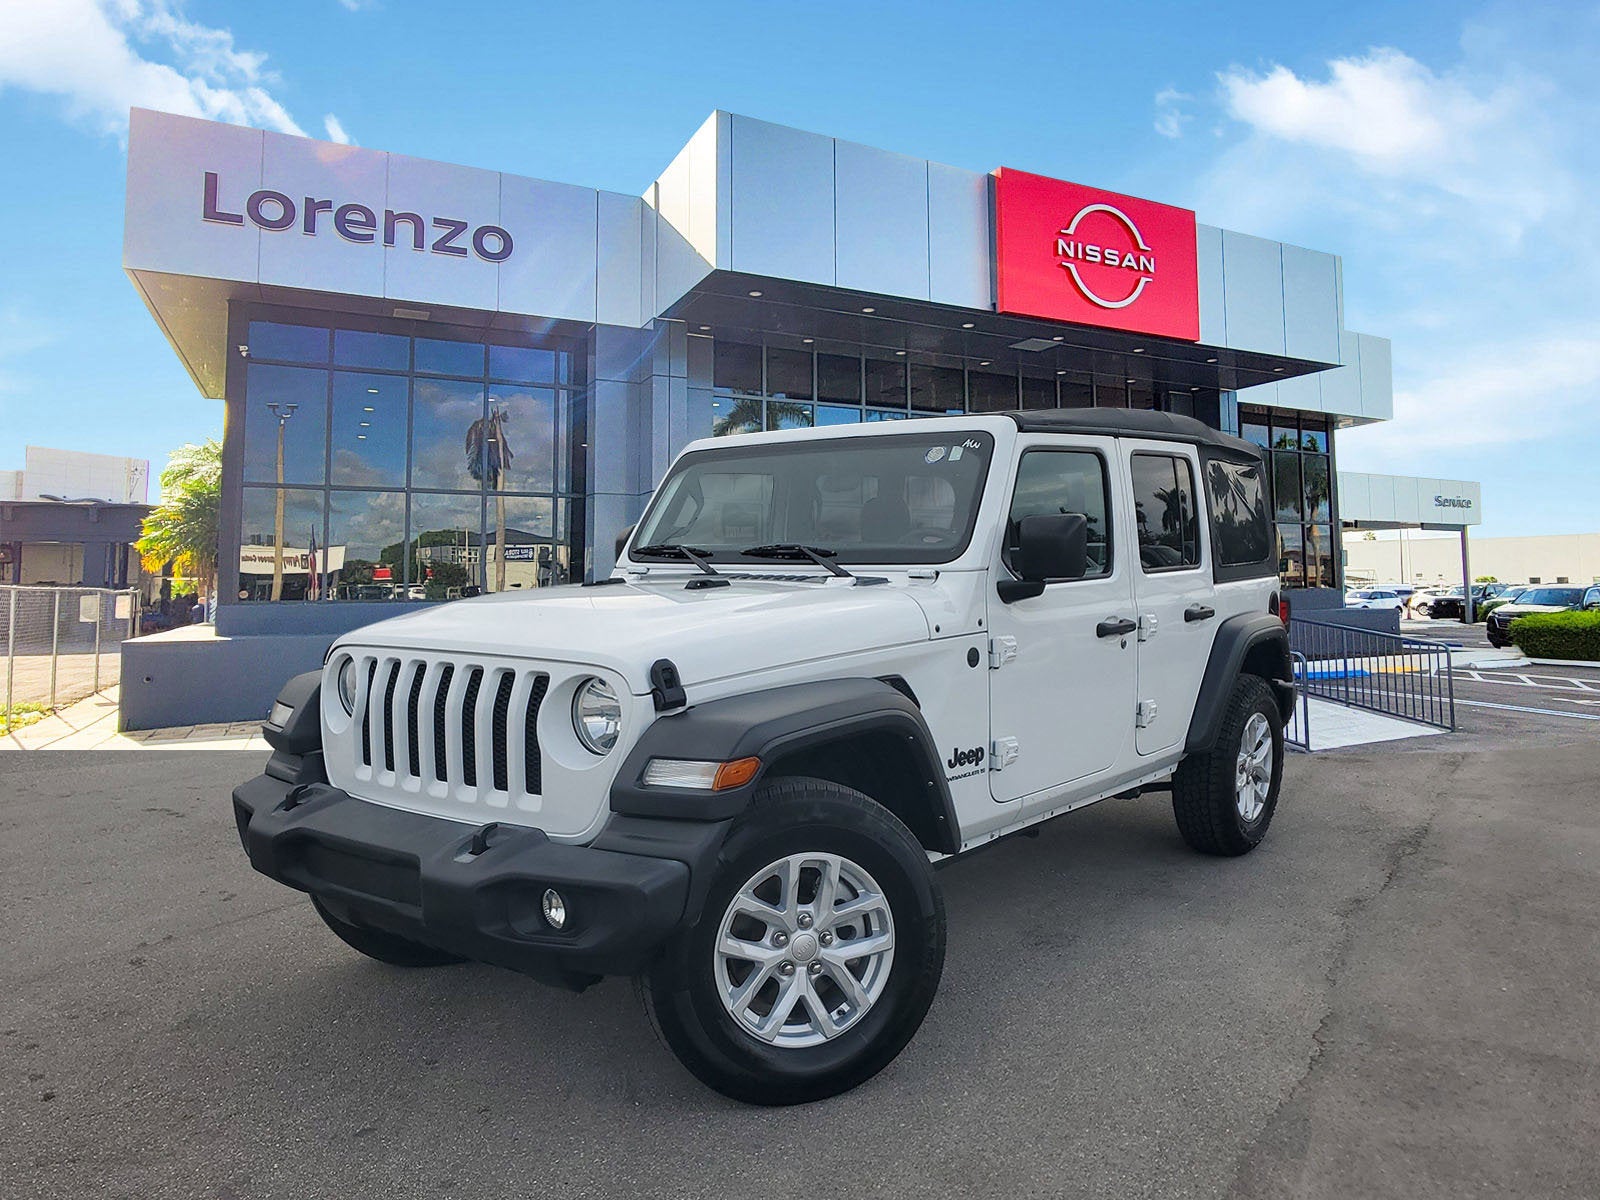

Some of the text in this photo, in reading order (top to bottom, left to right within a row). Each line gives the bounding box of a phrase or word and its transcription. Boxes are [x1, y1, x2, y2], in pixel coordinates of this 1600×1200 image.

[202, 171, 514, 263] Lorenzo
[1057, 238, 1155, 273] NISSAN
[1434, 495, 1472, 509] Service
[947, 746, 985, 769] Jeep
